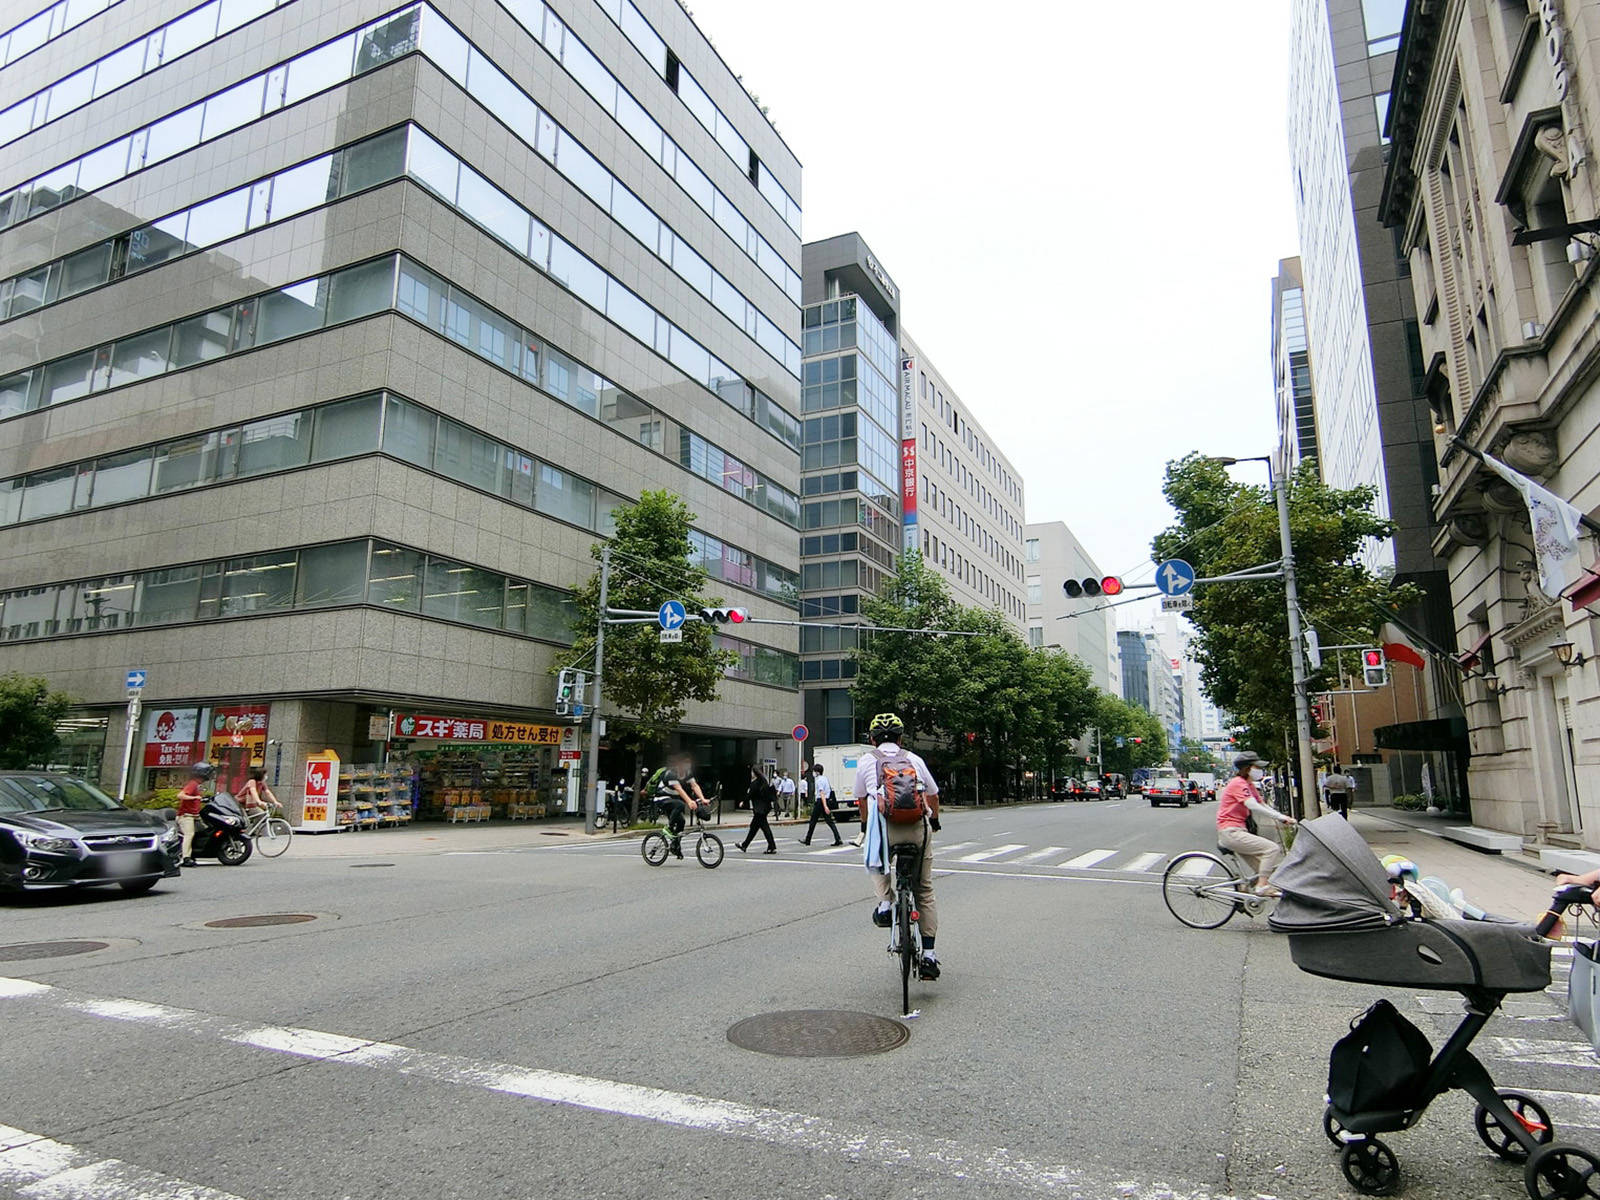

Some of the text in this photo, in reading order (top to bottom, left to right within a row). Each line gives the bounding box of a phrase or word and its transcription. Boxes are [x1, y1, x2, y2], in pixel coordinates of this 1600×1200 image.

[904, 459, 915, 497] 中京銀行
[416, 719, 485, 740] スギ薬局
[491, 724, 560, 743] 処方せん受付
[160, 743, 190, 754] Tax-free
